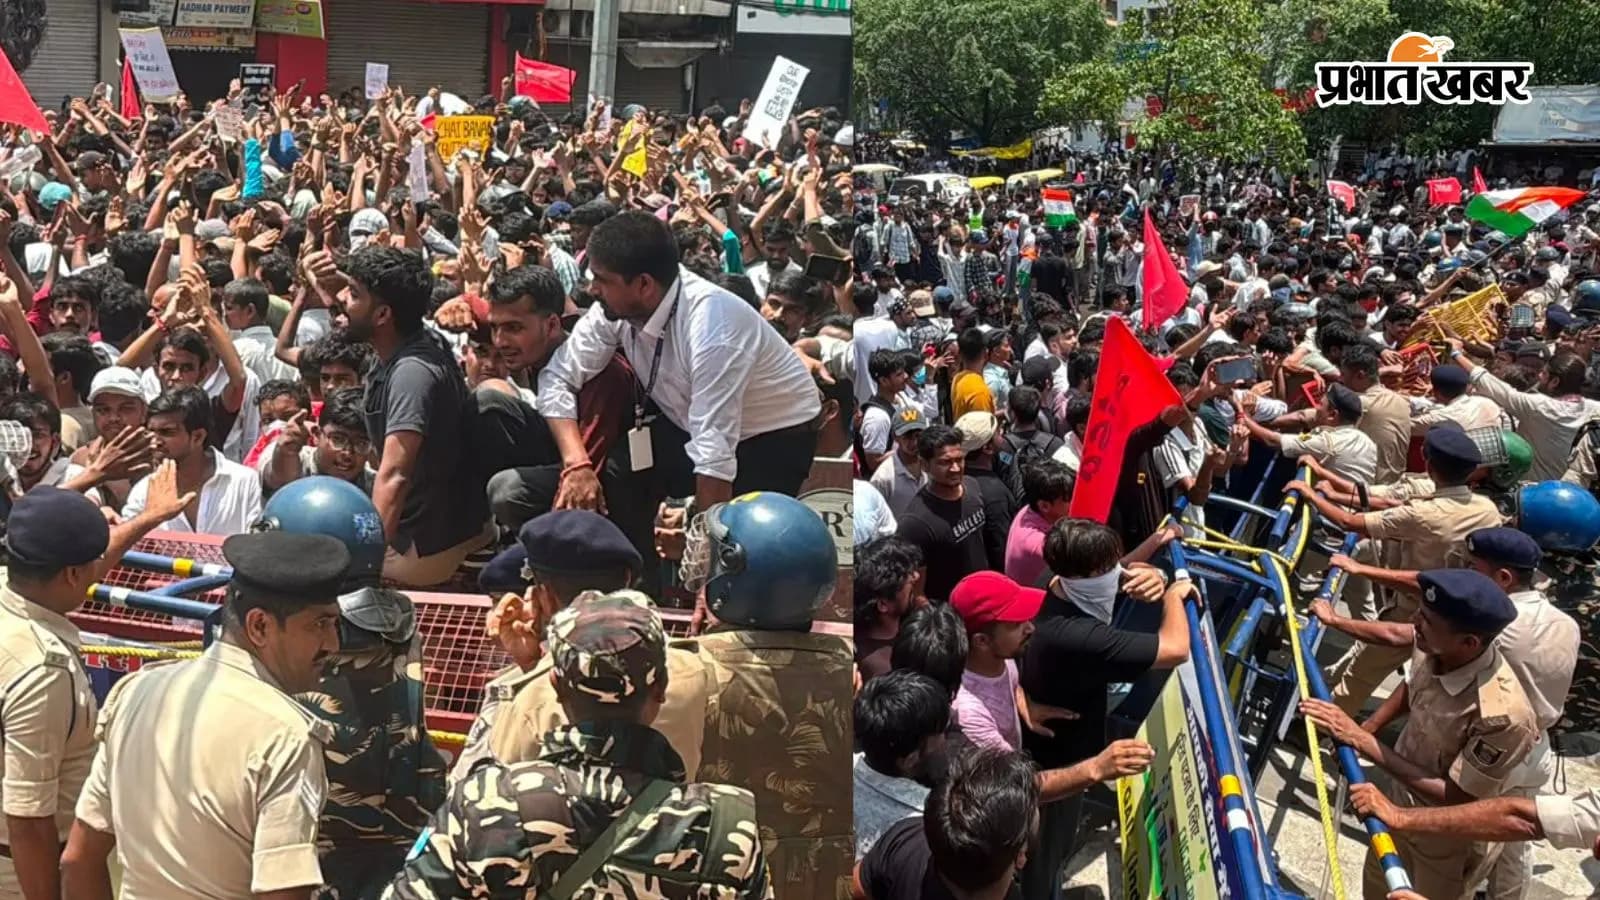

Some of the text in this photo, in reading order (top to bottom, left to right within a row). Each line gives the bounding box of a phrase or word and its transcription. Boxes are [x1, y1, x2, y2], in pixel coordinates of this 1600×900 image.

[180, 3, 212, 13] AADHAR
[214, 4, 251, 14] PAYMENT
[901, 409, 918, 422] W
